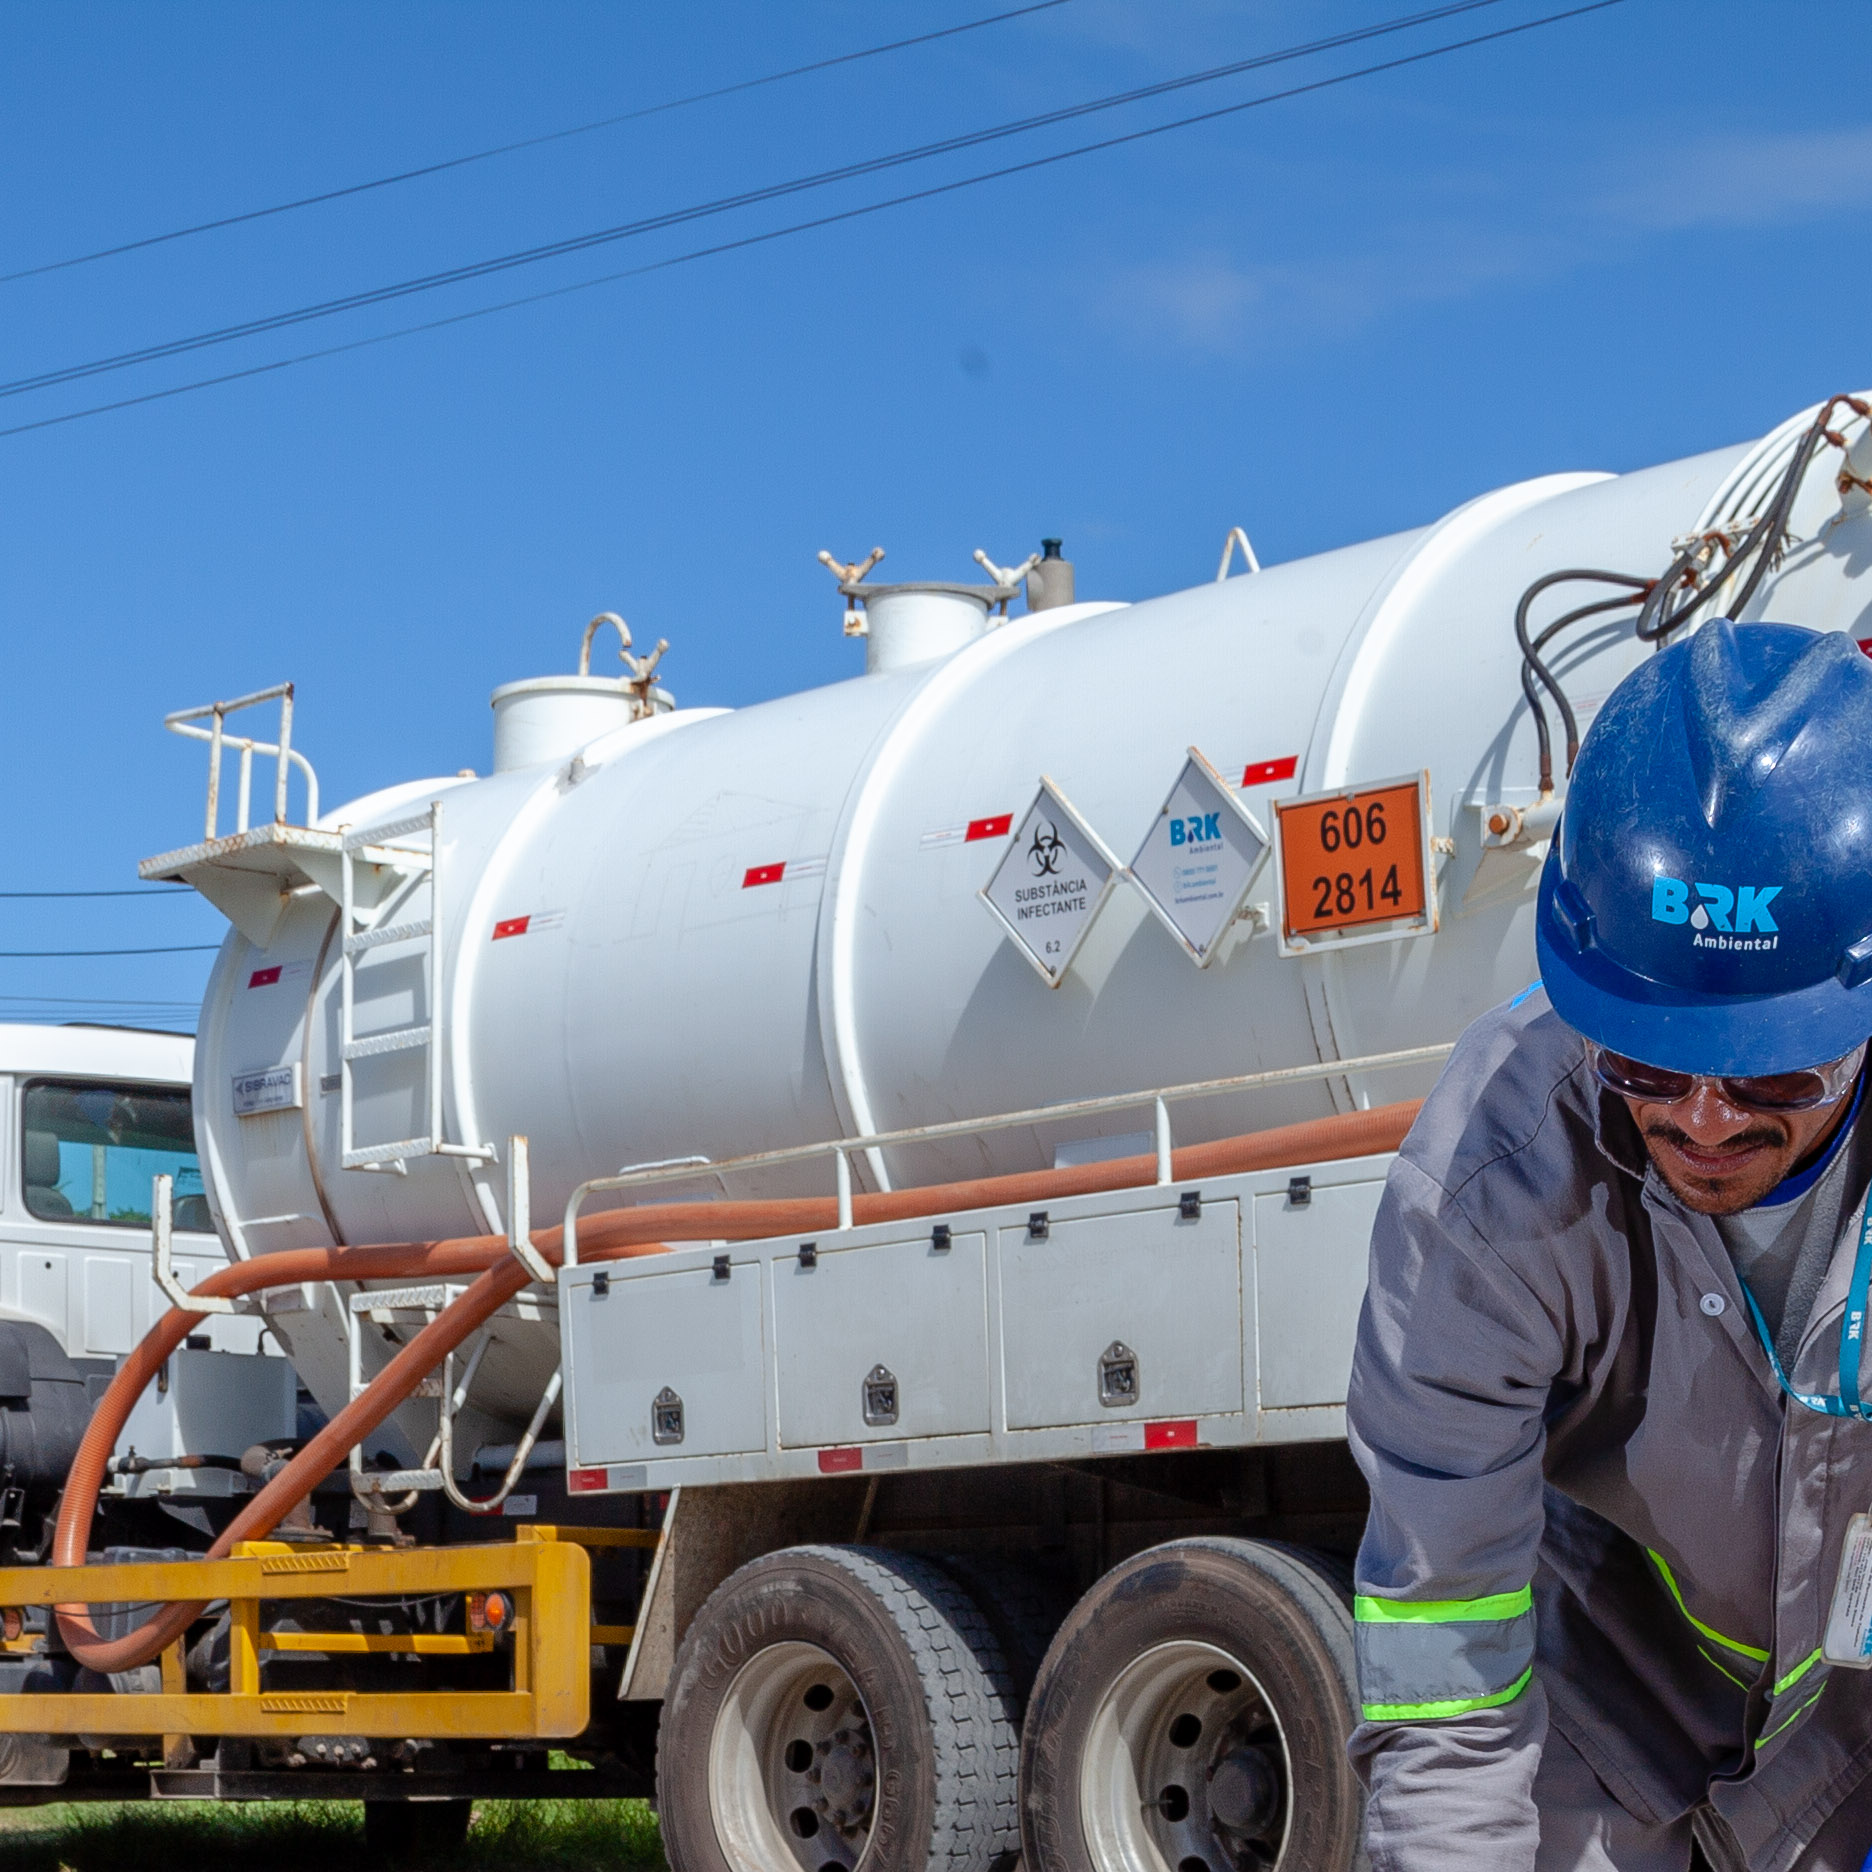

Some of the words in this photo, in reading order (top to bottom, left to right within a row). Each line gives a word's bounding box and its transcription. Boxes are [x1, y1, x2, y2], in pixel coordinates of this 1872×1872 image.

[1170, 812, 1221, 847] BRK
[1320, 802, 1386, 853] 606
[1015, 879, 1087, 902] SUBSTÂNCIA
[1313, 863, 1402, 919] 2814
[1652, 874, 1784, 932] BRK
[1017, 897, 1087, 920] INFECTANTE
[1045, 940, 1061, 953] 6.2
[1693, 933, 1779, 951] Ambiental
[1848, 1311, 1863, 1340] BRK
